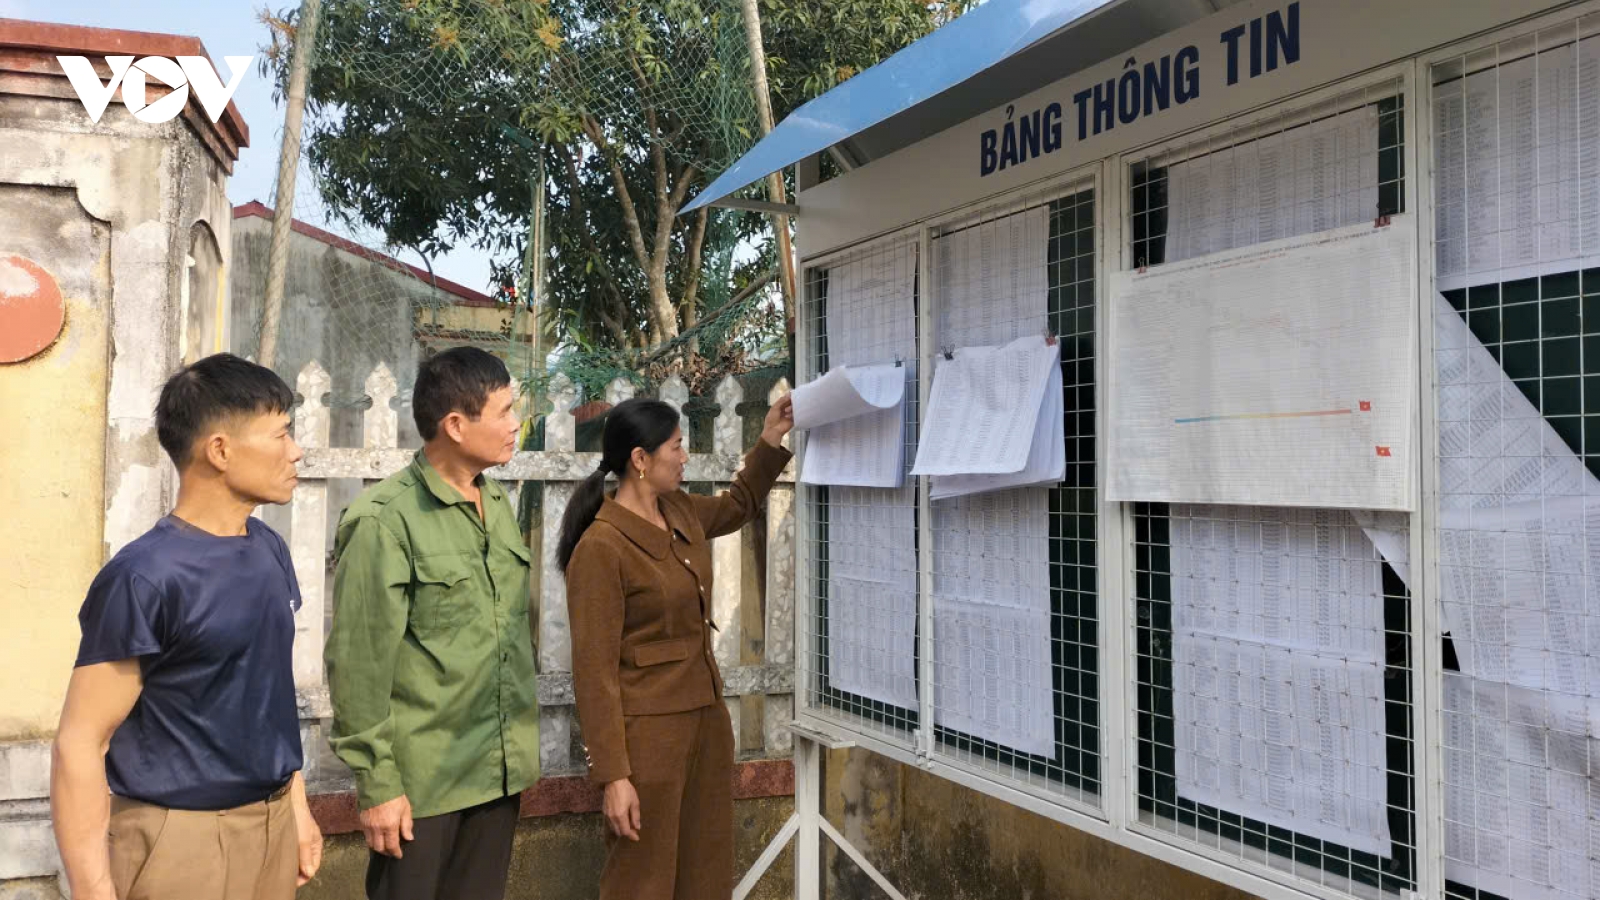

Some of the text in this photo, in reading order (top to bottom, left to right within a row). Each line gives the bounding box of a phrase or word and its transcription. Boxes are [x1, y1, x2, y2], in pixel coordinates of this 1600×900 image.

[980, 1, 1300, 177] BẢNG THÔNG TIN
